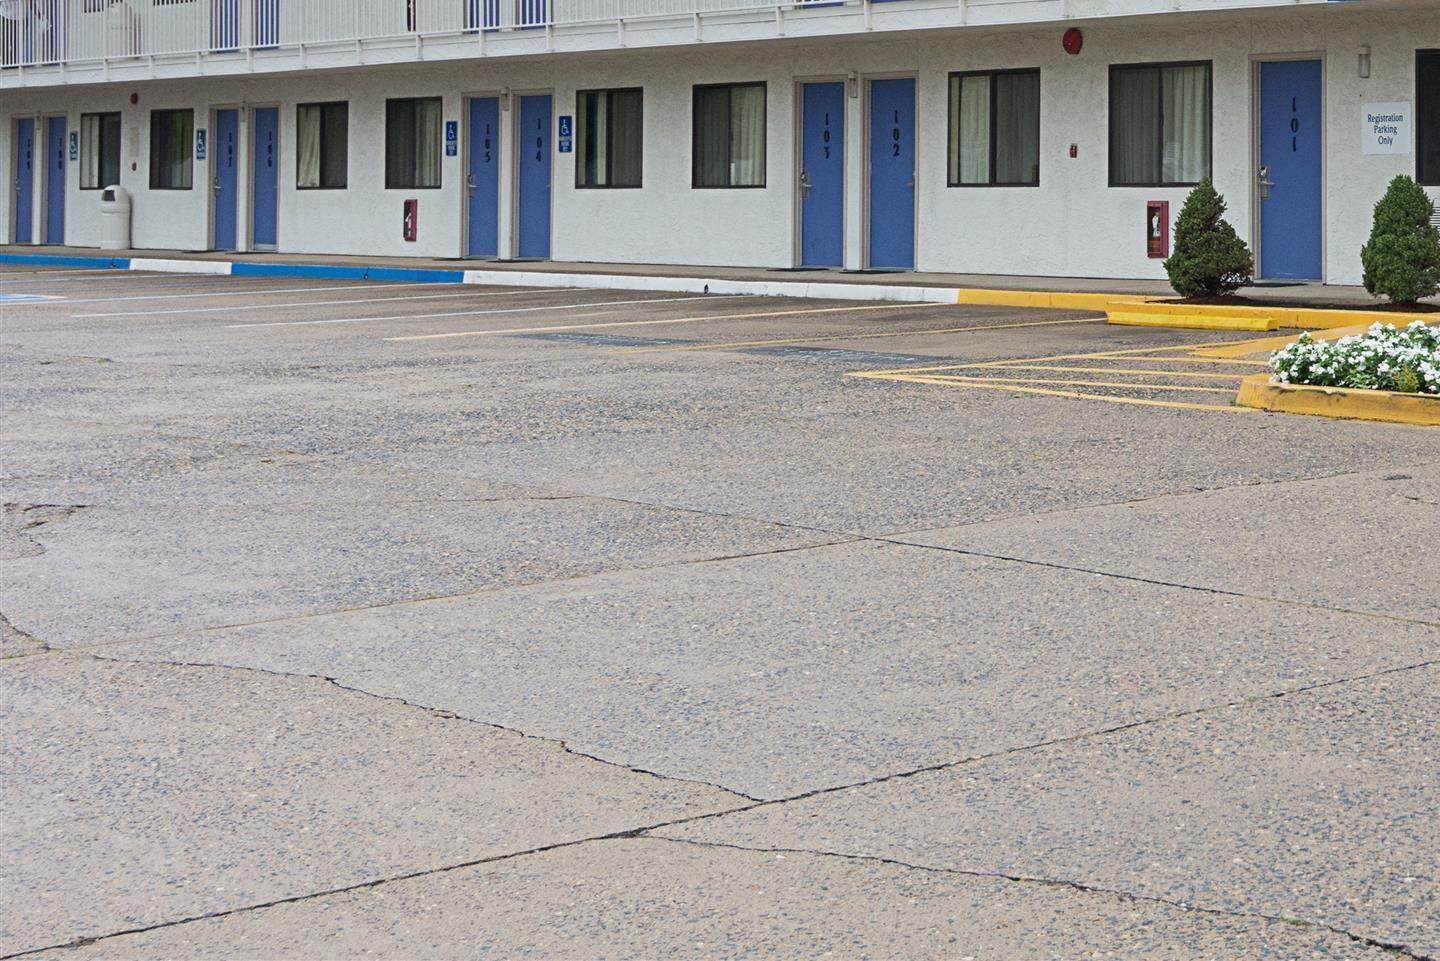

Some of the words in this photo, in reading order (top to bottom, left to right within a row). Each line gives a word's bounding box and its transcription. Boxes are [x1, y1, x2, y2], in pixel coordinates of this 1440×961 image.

[1290, 97, 1299, 152] 101
[1367, 113, 1404, 123] Registration
[1373, 125, 1398, 135] Parking
[823, 112, 831, 159] 103
[892, 109, 900, 157] 102
[1377, 136, 1393, 146] Only
